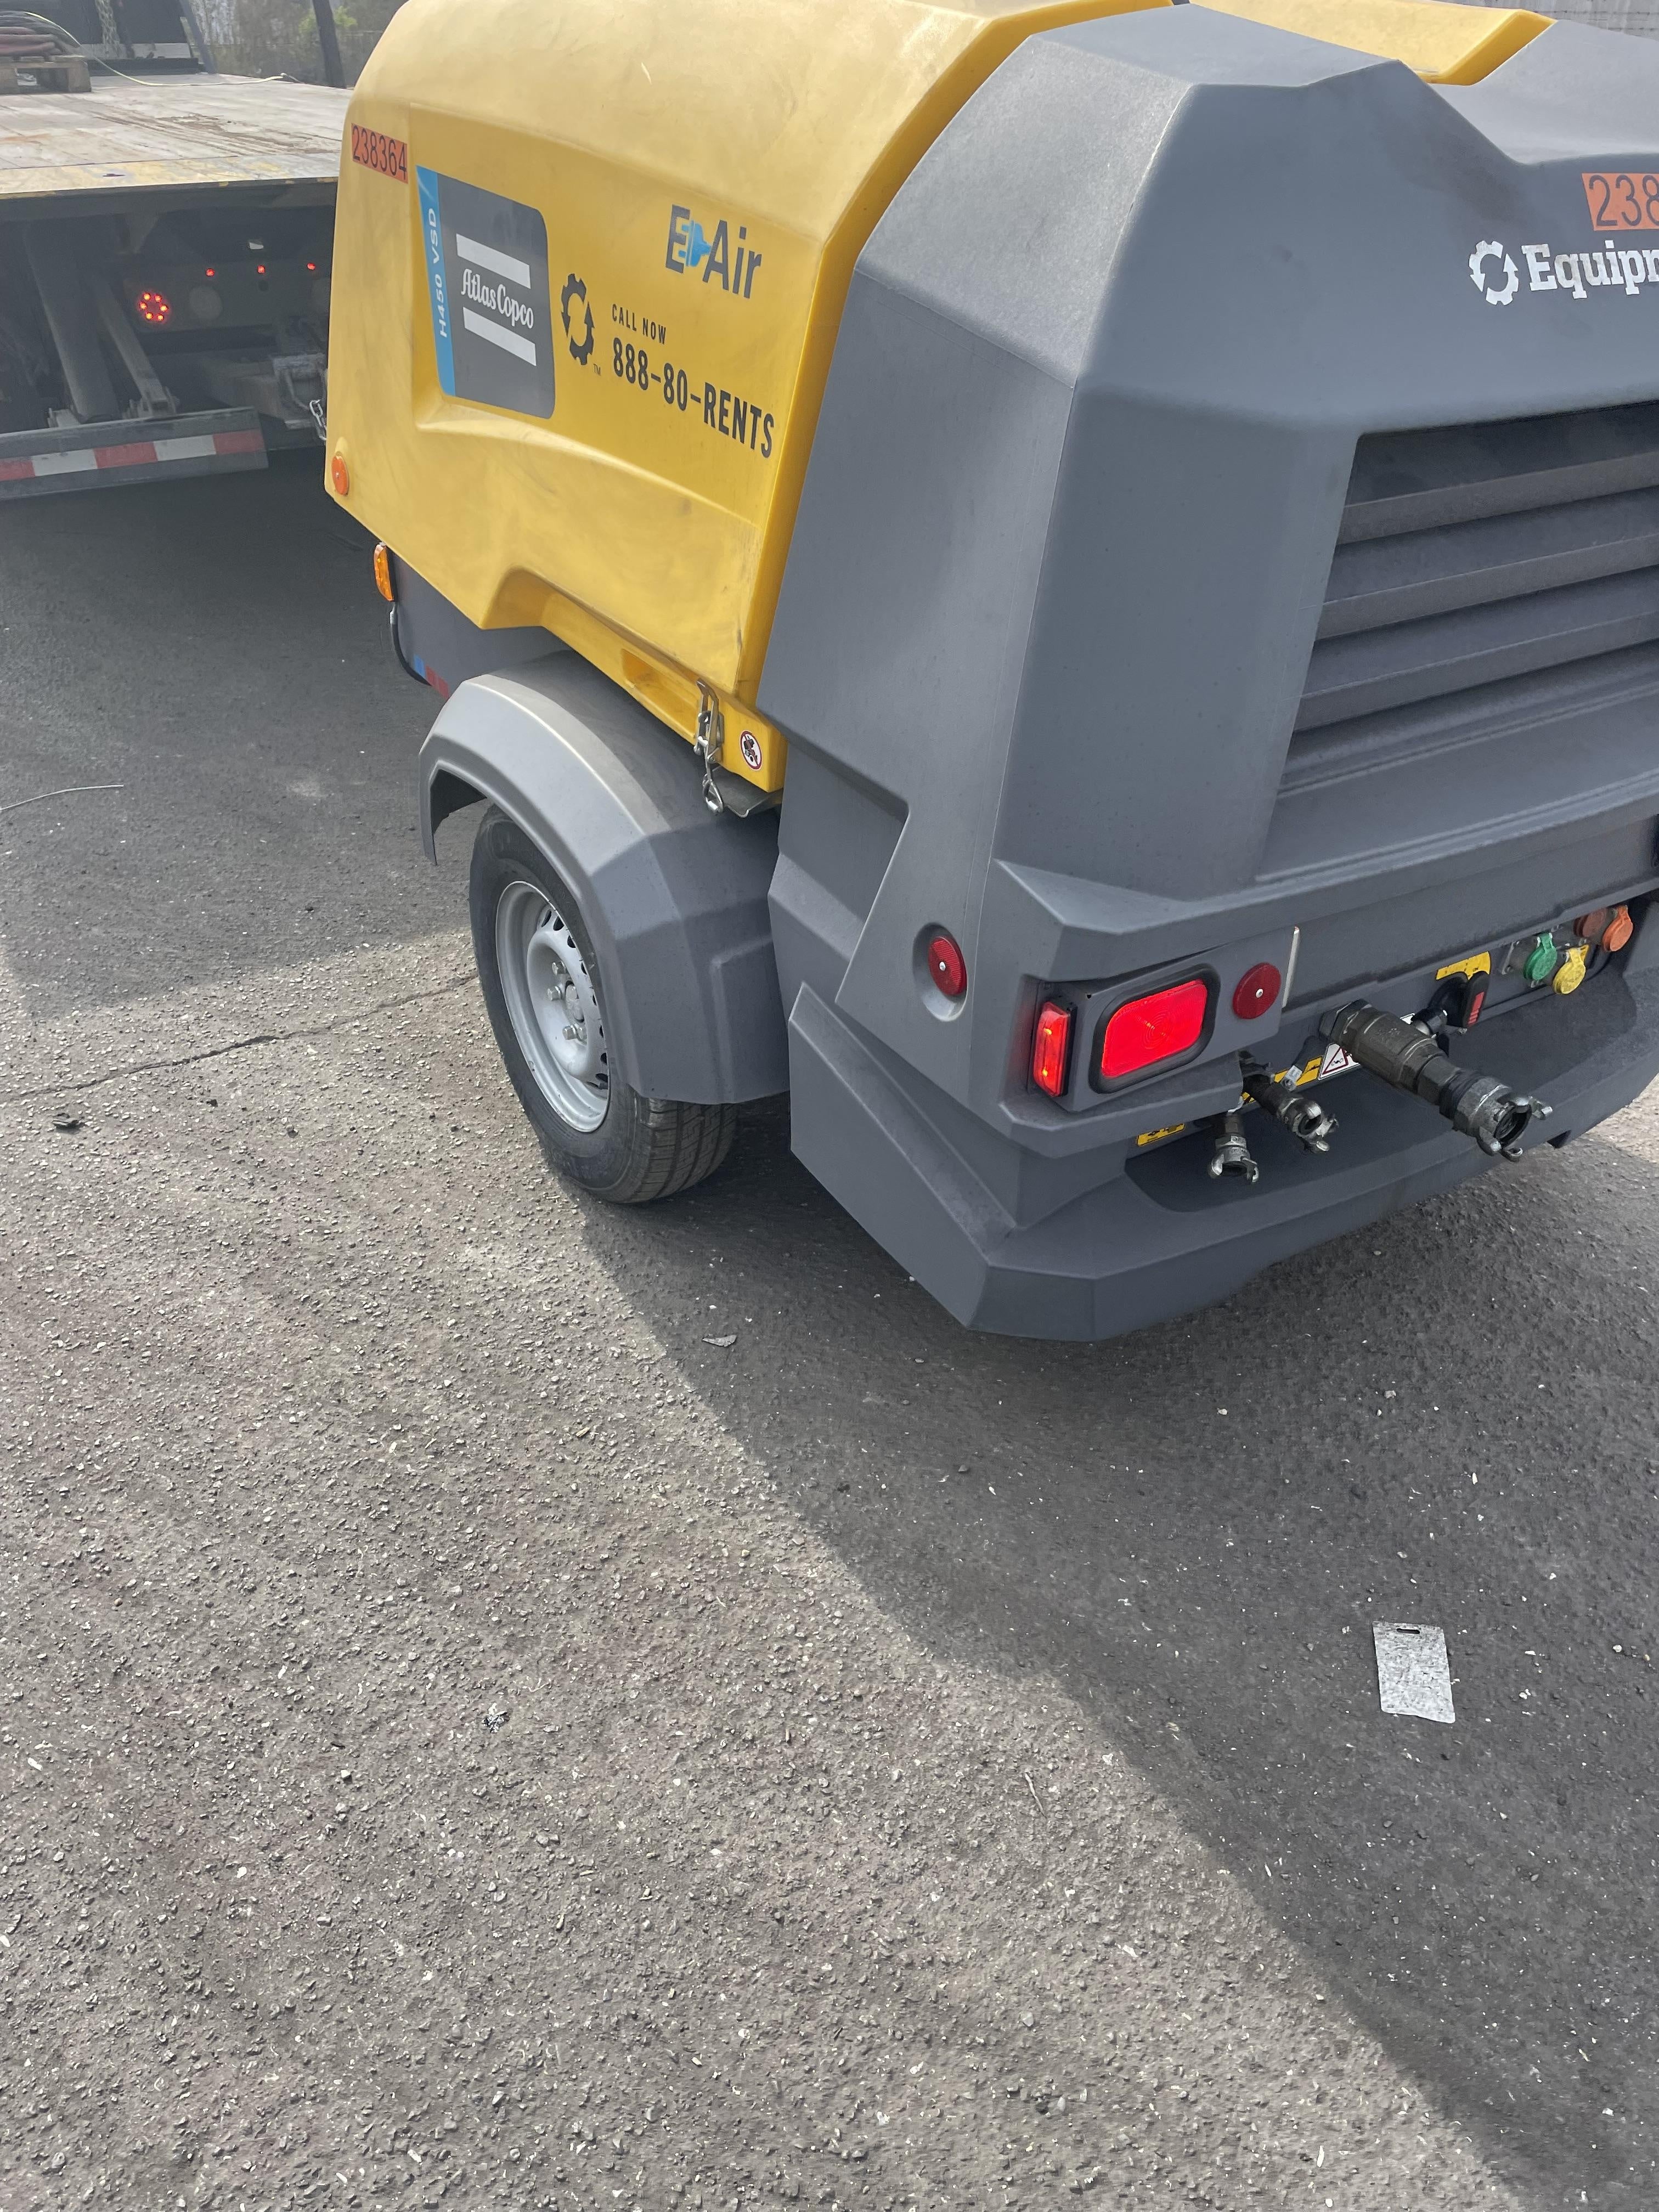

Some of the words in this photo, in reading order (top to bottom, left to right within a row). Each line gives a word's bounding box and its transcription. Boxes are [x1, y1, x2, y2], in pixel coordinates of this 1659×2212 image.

[352, 125, 407, 180] 238364
[428, 208, 440, 264] VSD
[435, 274, 448, 338] H450
[612, 303, 637, 332] CALL
[642, 317, 667, 345] NOW
[613, 337, 775, 459] 888-80-RENTS
